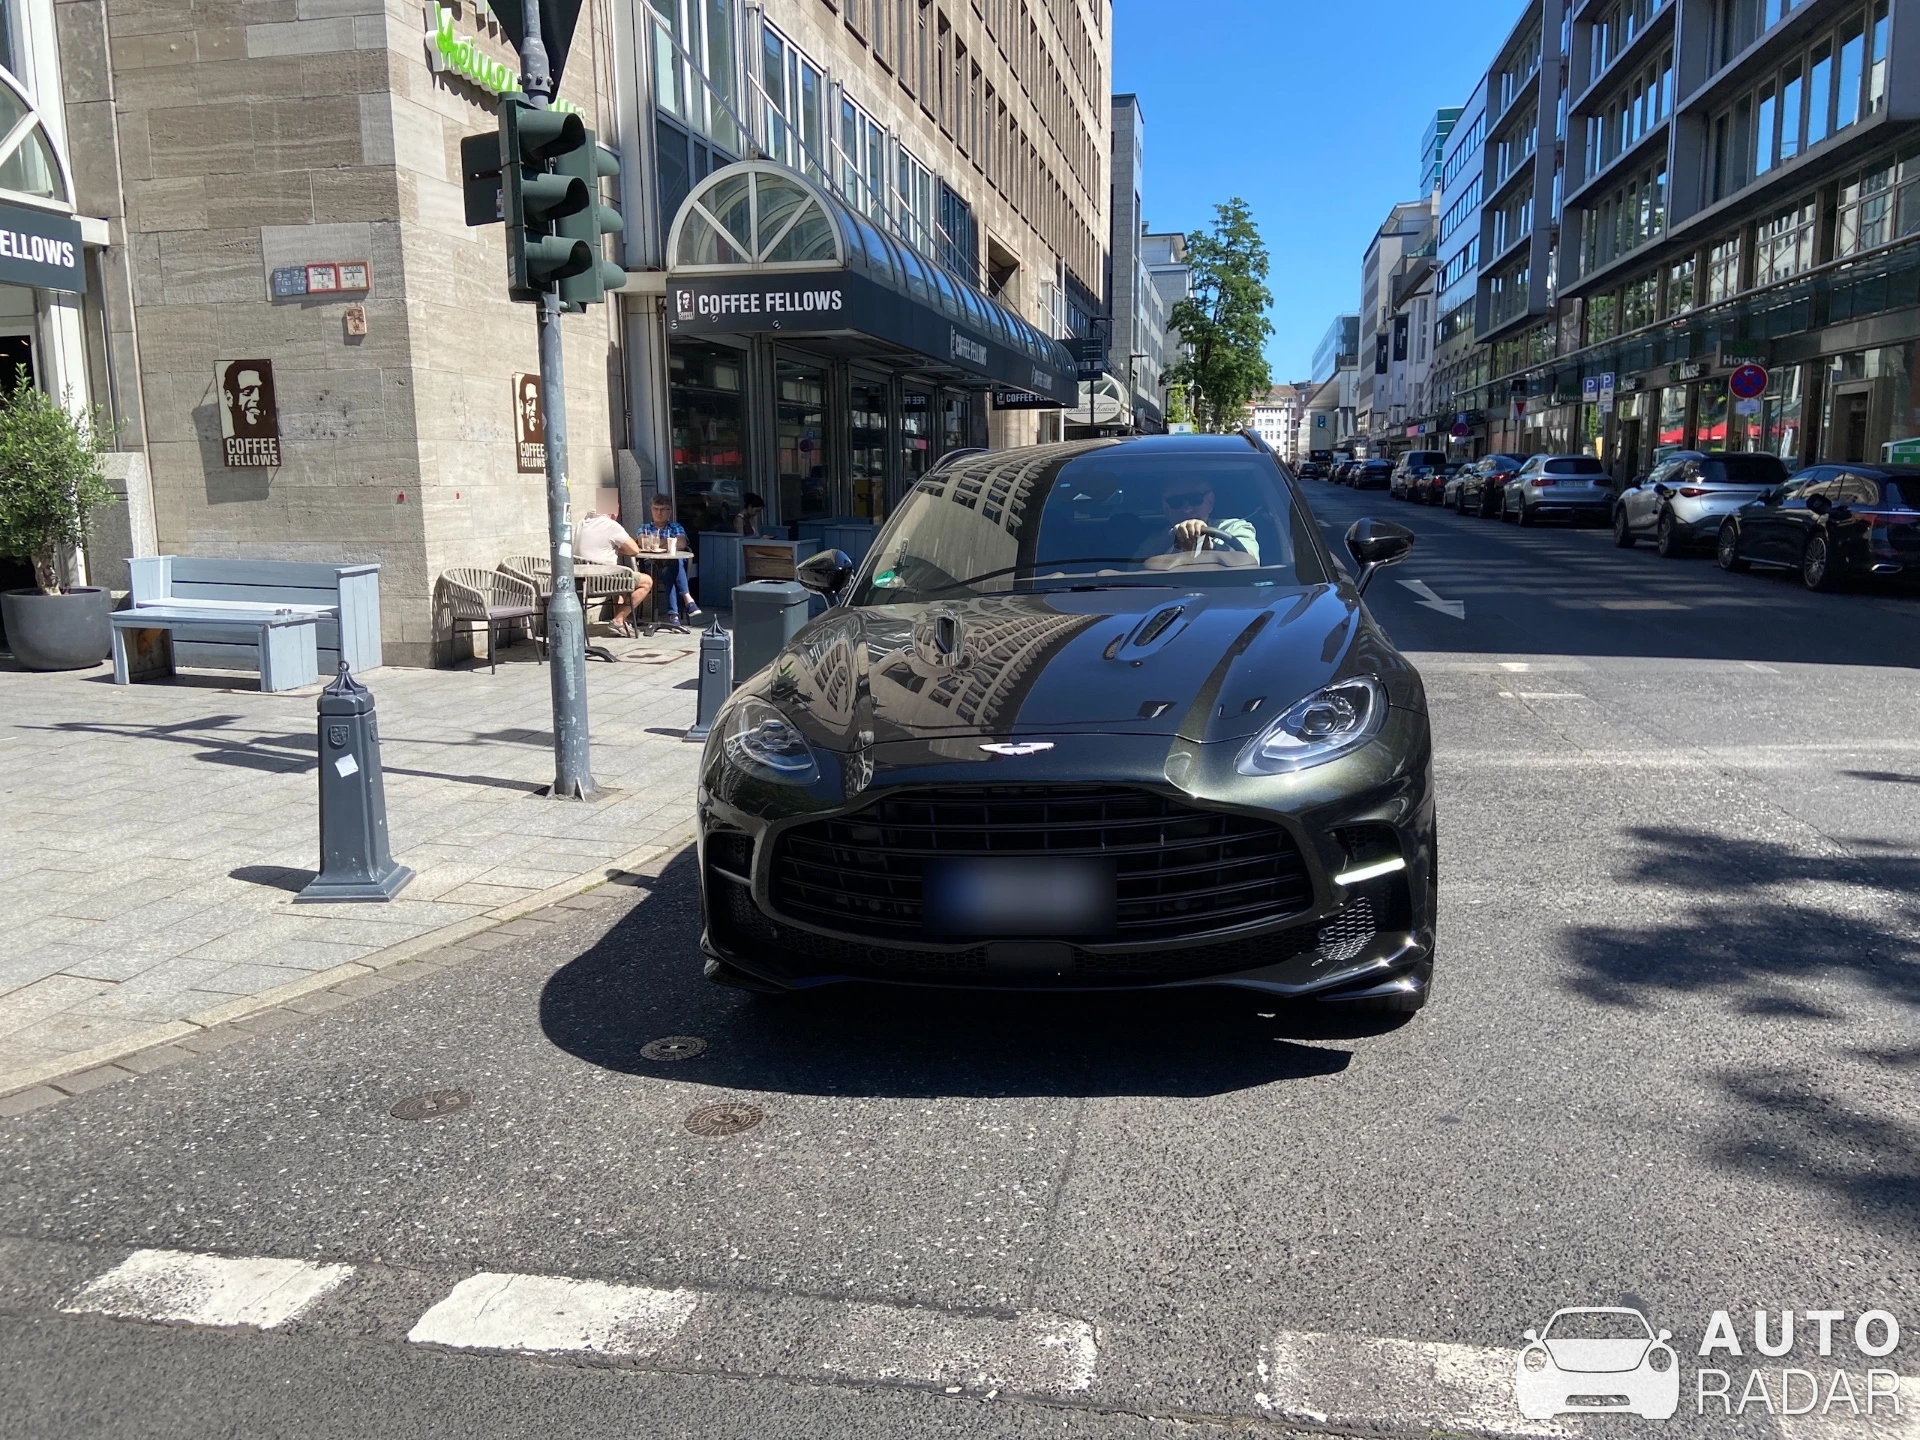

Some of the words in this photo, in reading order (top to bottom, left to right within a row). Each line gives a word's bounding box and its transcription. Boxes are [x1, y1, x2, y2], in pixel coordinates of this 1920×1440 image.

[0, 229, 75, 268] ELLOWS
[698, 294, 760, 315] COFFEE
[765, 290, 842, 313] FELLOWS
[1586, 379, 1595, 393] P
[1603, 374, 1611, 389] P
[1006, 393, 1034, 403] COFFEE
[226, 437, 278, 455] COFFEE
[520, 442, 545, 458] COFFEE
[227, 454, 279, 466] FELLOWS
[521, 457, 546, 468] FELLOWS
